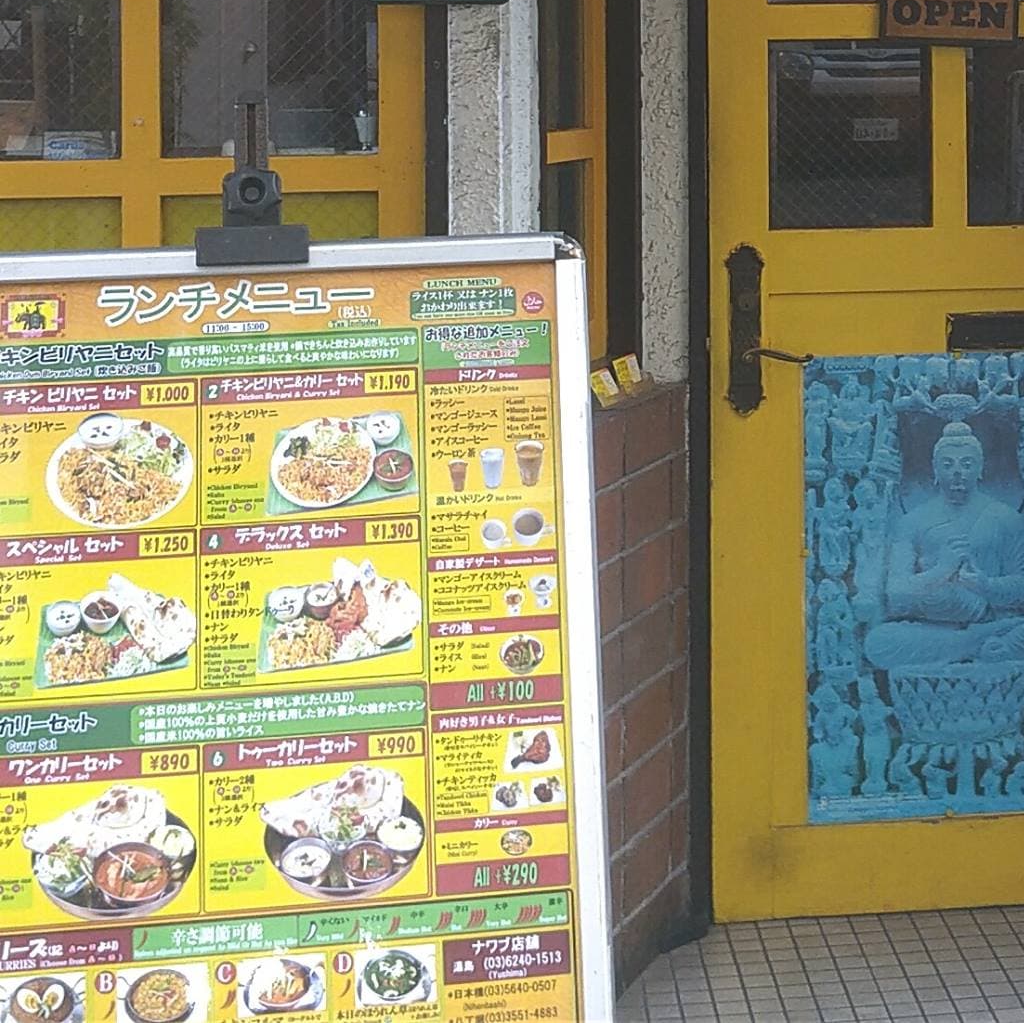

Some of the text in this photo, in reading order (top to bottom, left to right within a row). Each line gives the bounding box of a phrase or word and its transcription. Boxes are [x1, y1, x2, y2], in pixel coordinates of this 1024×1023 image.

[427, 278, 497, 289] LUNCH MENU
[98, 280, 375, 325] ランチメニュー
[336, 373, 363, 387] セット
[458, 369, 496, 382] ドリンク
[3, 384, 137, 405] チキン ビリヤニ セット
[208, 384, 218, 398] 2
[214, 408, 279, 420] チキンビリヤニ
[215, 422, 241, 433] ライタ
[213, 464, 242, 475] サラダ
[235, 522, 347, 544] デラックス セット
[6, 536, 124, 558] スペシャル セット
[208, 534, 219, 549] 4
[209, 557, 273, 569] チキンビリヤニ
[210, 569, 236, 581] ライタ
[437, 622, 473, 636] その他
[210, 633, 239, 644] サラダ
[439, 641, 465, 651] サラダ
[439, 653, 463, 662] ライス
[439, 664, 456, 673] ナン
[467, 683, 484, 703] All
[238, 736, 358, 761] トゥーカリーセット
[377, 736, 416, 754] ¥990
[8, 753, 123, 777] ワンカリーセット
[149, 754, 190, 771] ¥890
[212, 752, 223, 766] 6
[214, 815, 244, 827] サラダ
[473, 866, 490, 888] All
[471, 935, 540, 955] ナワブ店舗
[337, 953, 351, 971] D
[483, 950, 562, 971] (03)6240-1513
[219, 963, 233, 983] C
[99, 972, 114, 993] B
